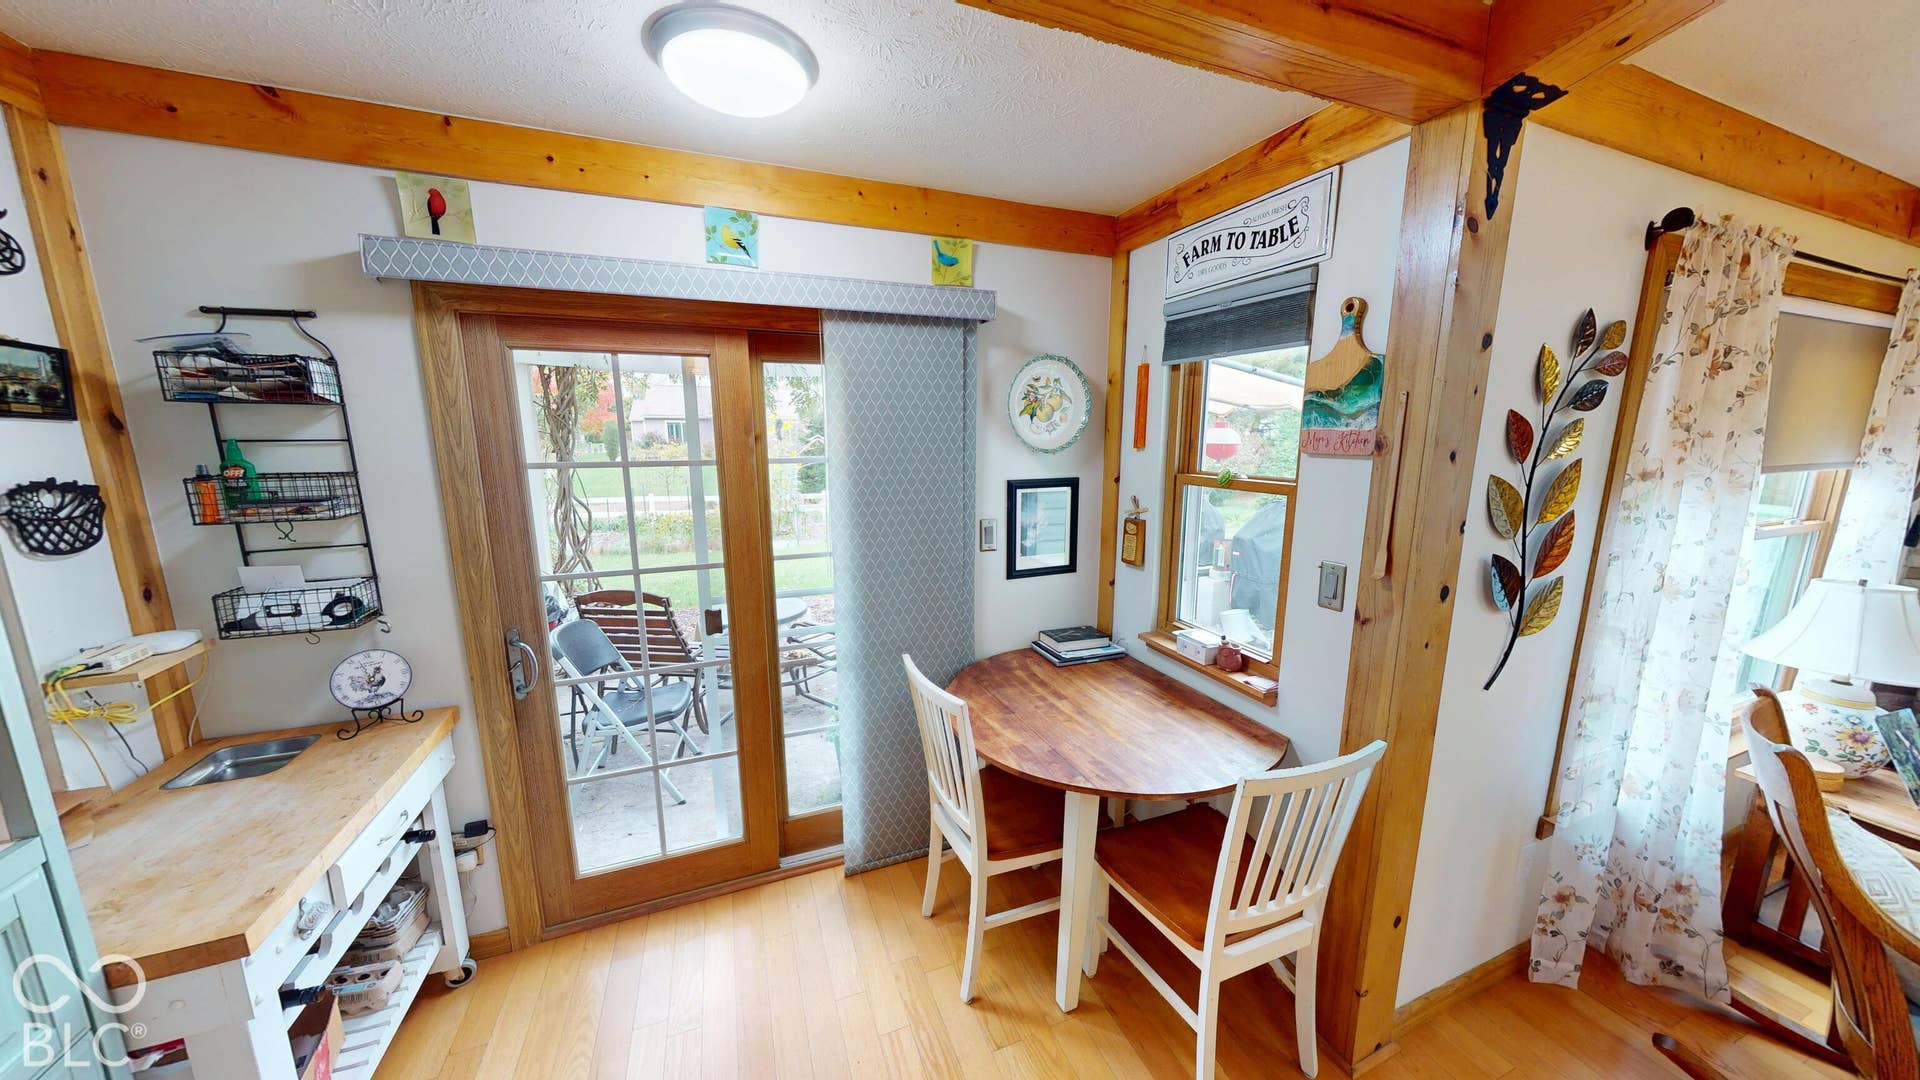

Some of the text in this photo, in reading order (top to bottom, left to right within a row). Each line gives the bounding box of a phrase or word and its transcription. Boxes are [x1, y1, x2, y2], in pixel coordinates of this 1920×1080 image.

[1182, 215, 1300, 268] FARM TO TABLE
